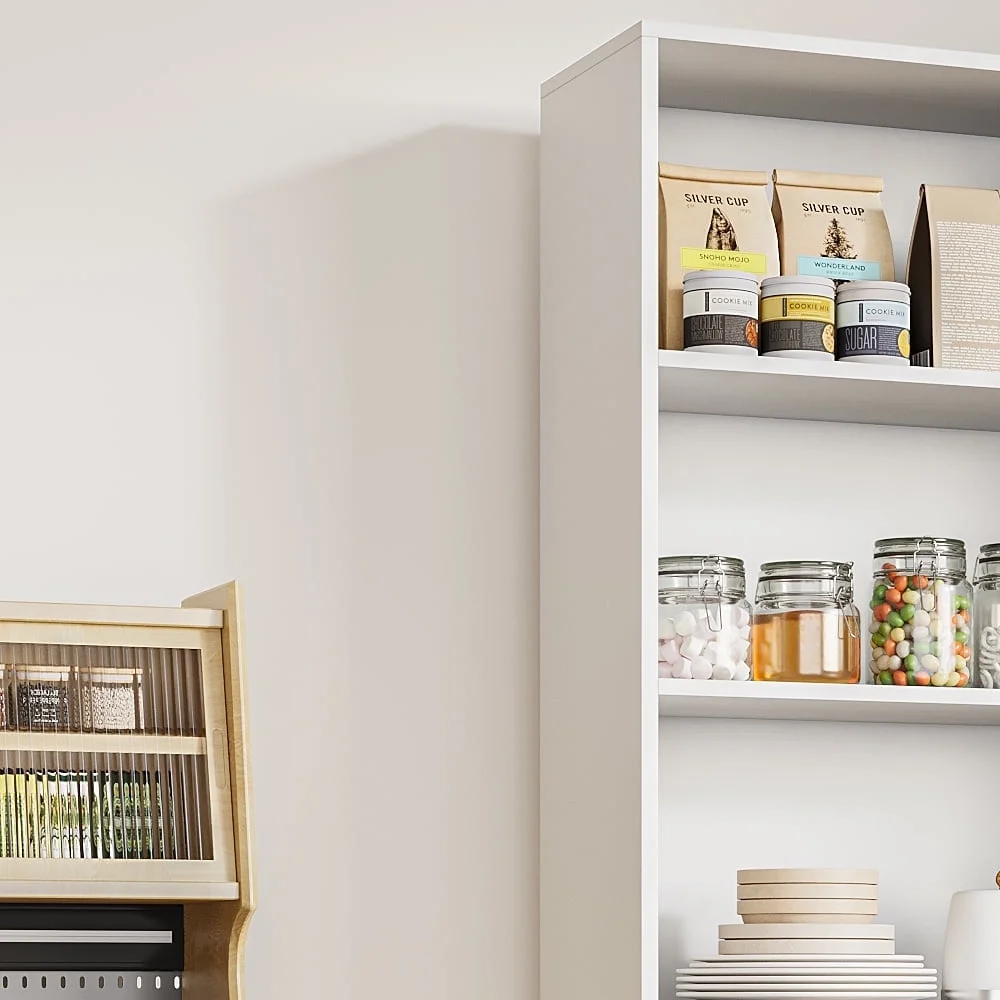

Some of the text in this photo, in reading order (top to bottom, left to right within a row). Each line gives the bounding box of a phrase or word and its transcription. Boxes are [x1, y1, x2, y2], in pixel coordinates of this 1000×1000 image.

[684, 193, 749, 207] SILVER CUP
[801, 202, 865, 216] SILVER CUP
[699, 253, 727, 262] SNOHO
[813, 261, 866, 272] WONDERLAND
[711, 297, 741, 305] COOKIE
[789, 303, 818, 312] COOKIE
[865, 308, 895, 316] COOKIE
[845, 326, 877, 351] SUGAR
